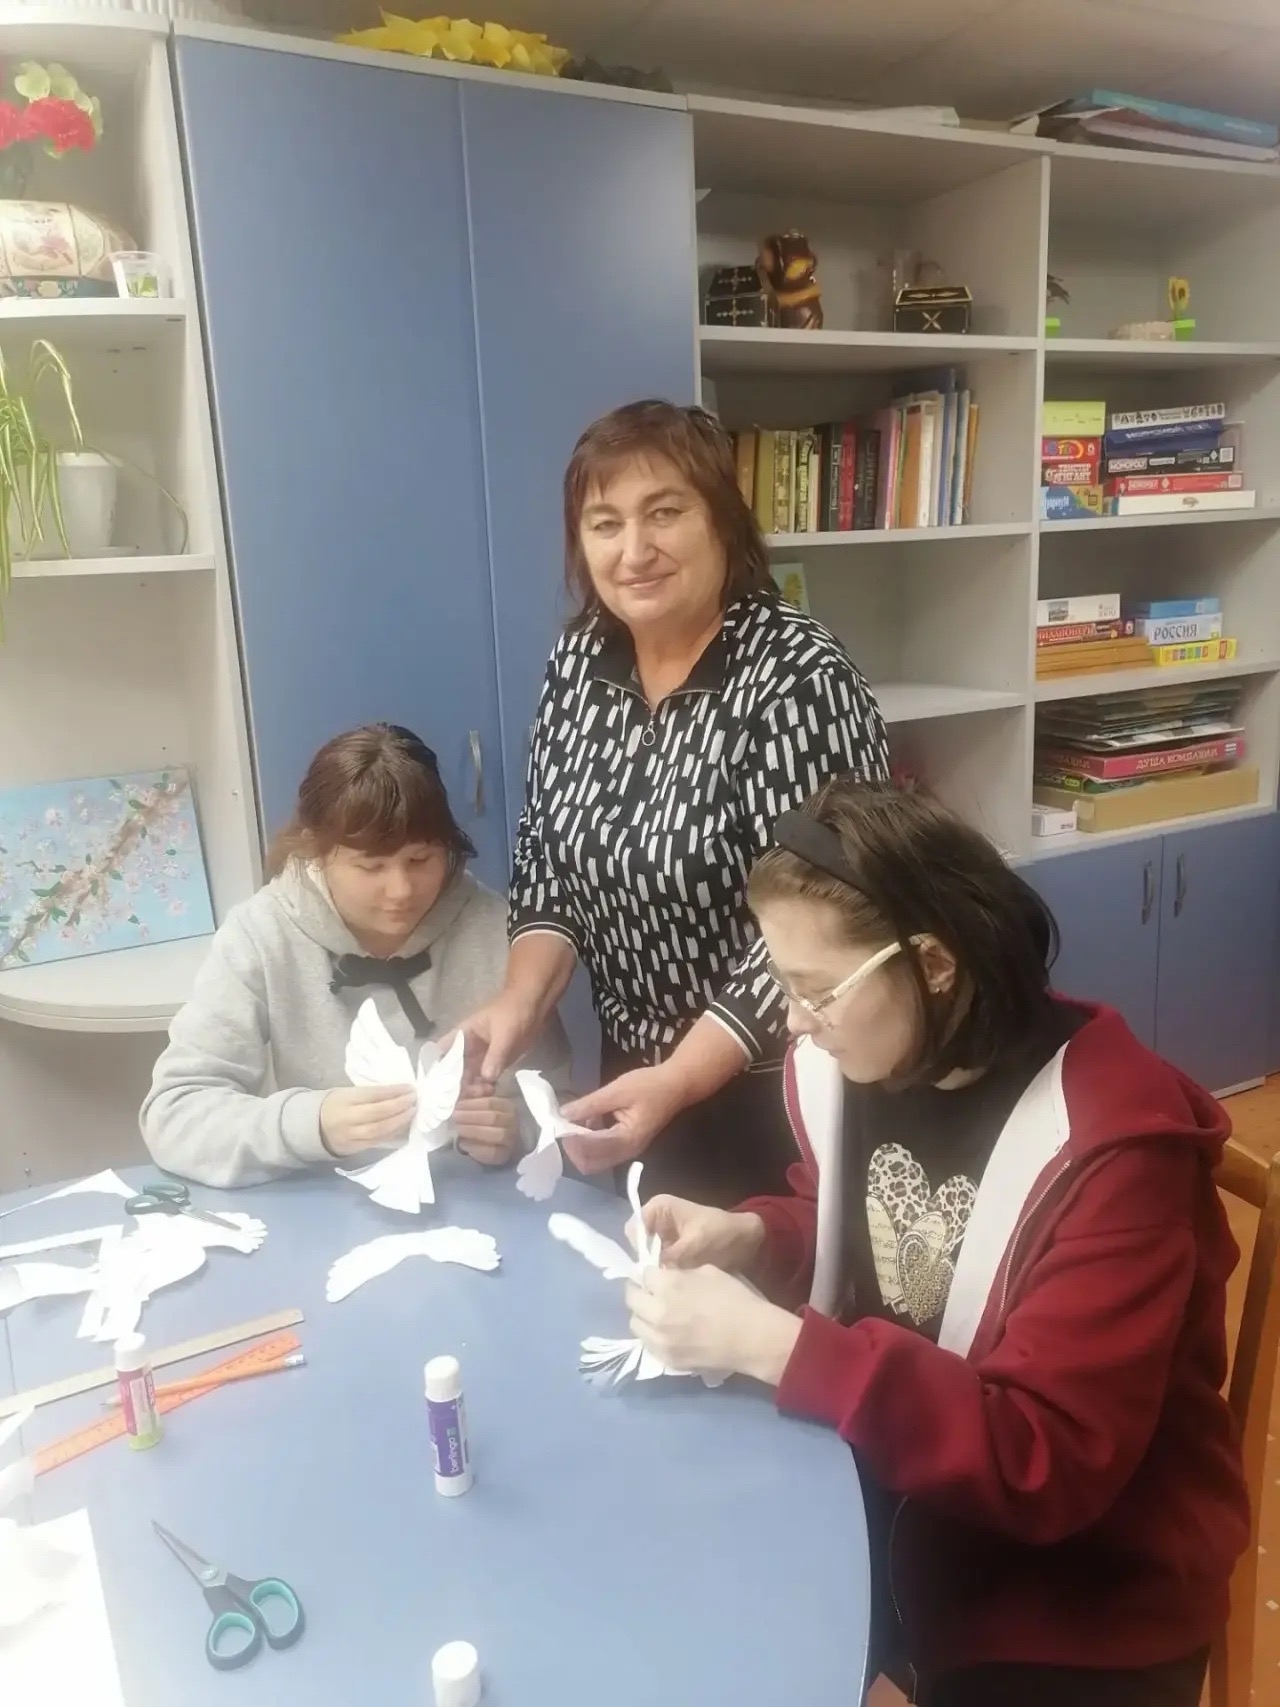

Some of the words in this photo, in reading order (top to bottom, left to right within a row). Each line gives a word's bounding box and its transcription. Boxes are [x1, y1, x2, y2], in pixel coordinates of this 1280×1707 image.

[1108, 459, 1146, 472] MONOPOLY
[1154, 624, 1197, 640] РОССИЯ
[1136, 756, 1166, 769] ДУША
[1167, 747, 1218, 764] КОМПАНИИ
[448, 1437, 460, 1473] berlingo
